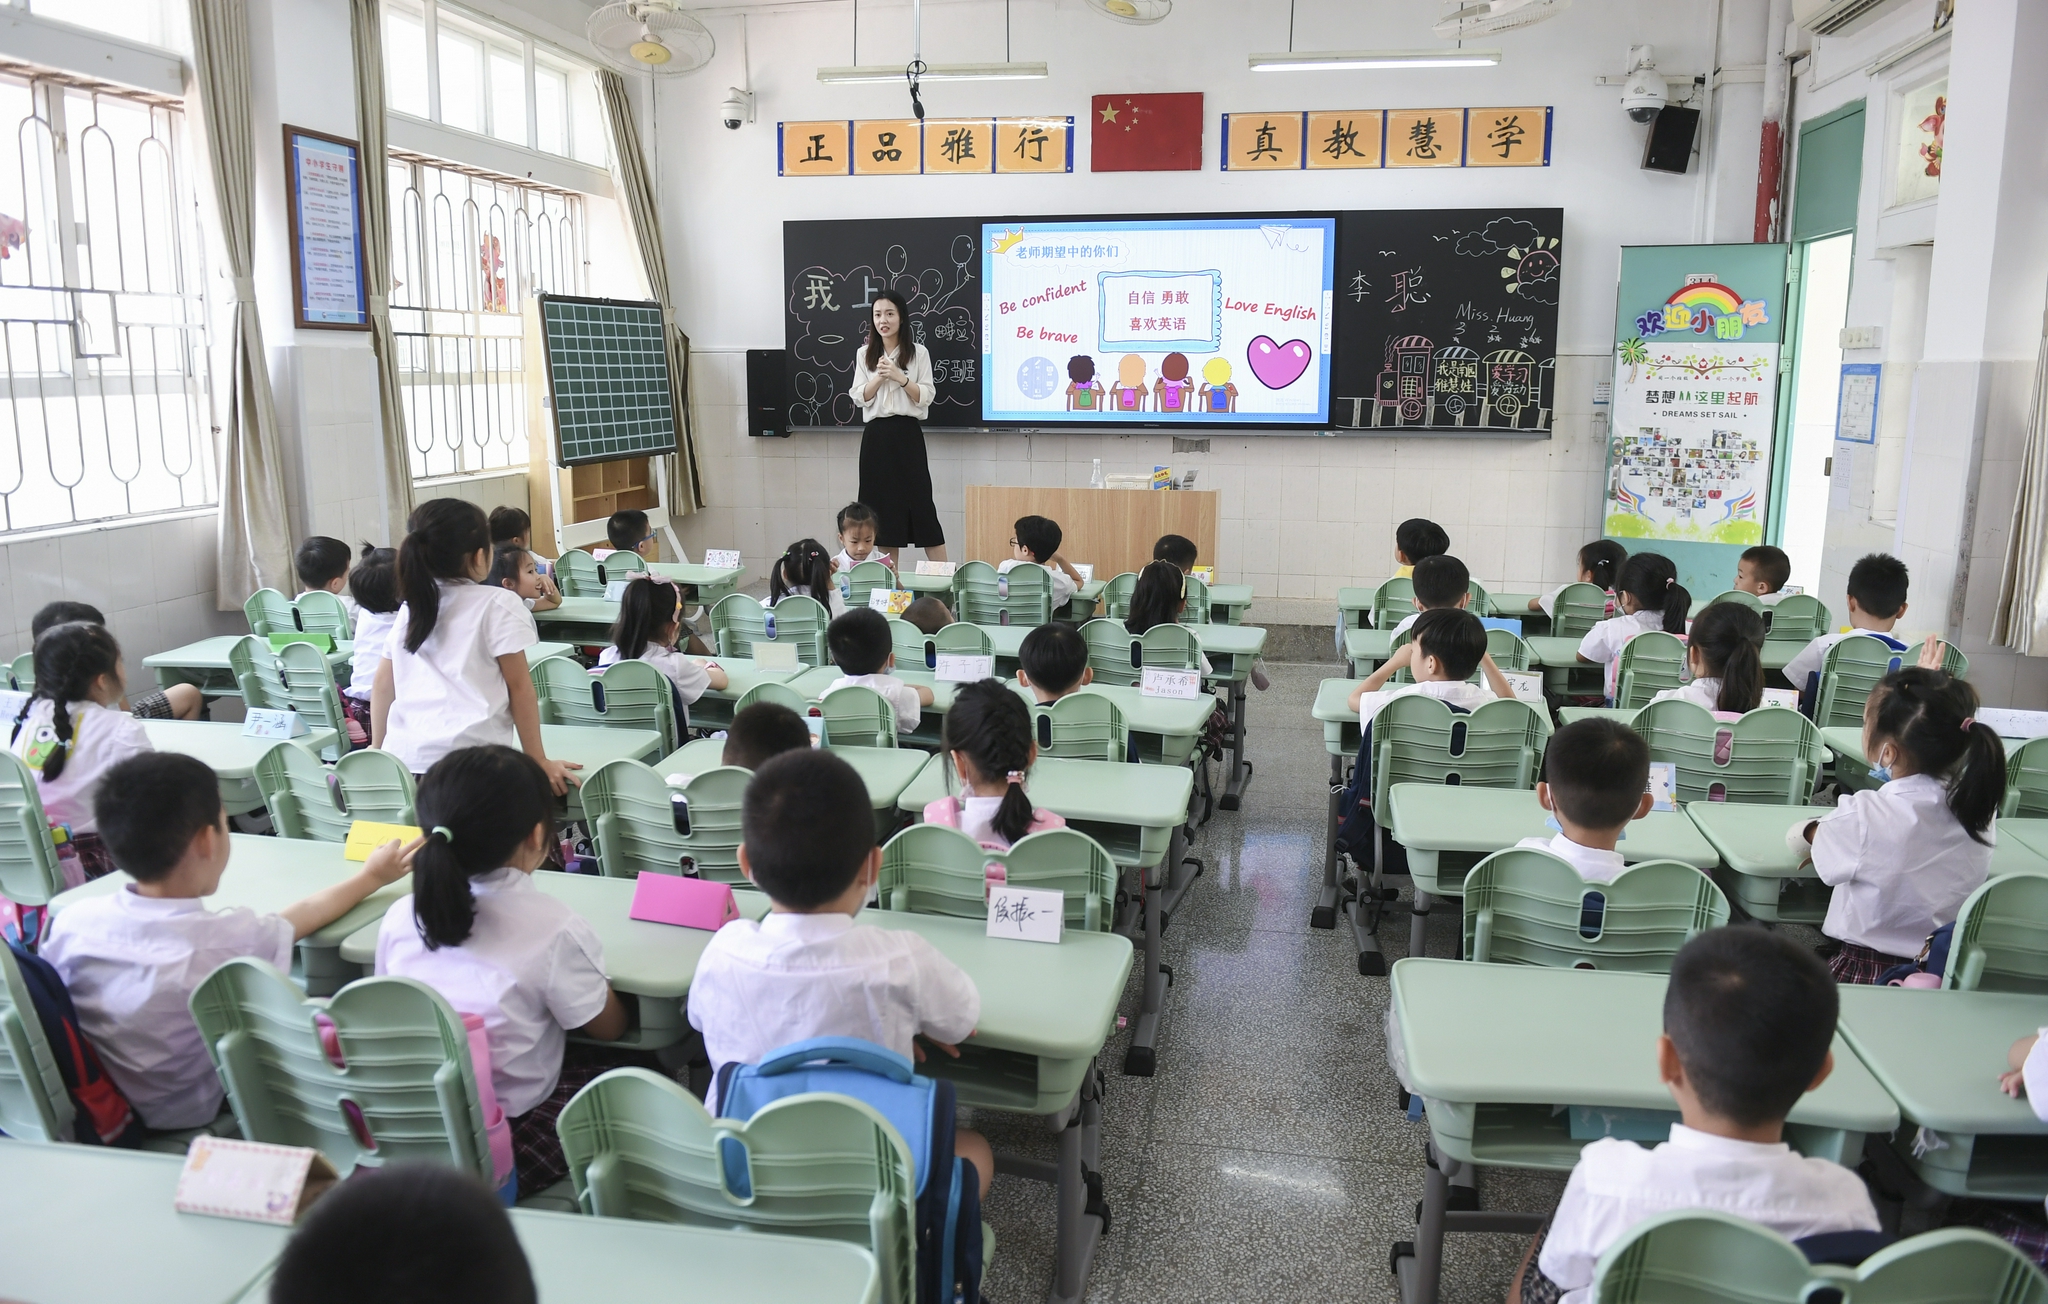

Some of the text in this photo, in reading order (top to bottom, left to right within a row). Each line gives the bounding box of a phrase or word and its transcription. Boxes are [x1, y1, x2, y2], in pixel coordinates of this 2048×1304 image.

[800, 127, 1049, 165] 正品雅行
[1247, 115, 1525, 162] 真教慧学
[1015, 245, 1120, 259] 老师期望中的你们
[999, 280, 1088, 315] Be confident
[1128, 290, 1190, 305] 自信 勇敢
[1225, 297, 1317, 322] Love English
[1128, 317, 1187, 331] 喜欢英语
[1496, 307, 1535, 331] Huang
[1636, 302, 1769, 340] 欢迎小朋友
[1016, 326, 1079, 344] Be brave
[1491, 364, 1529, 384] 爱学习
[1490, 380, 1527, 397] 爱劳动
[1645, 390, 1759, 406] 梦想从这里起航
[1662, 410, 1699, 418] DREAMS
[1718, 411, 1738, 419] SAIL
[1153, 672, 1189, 687] 卢承希
[1154, 685, 1183, 696] Jason
